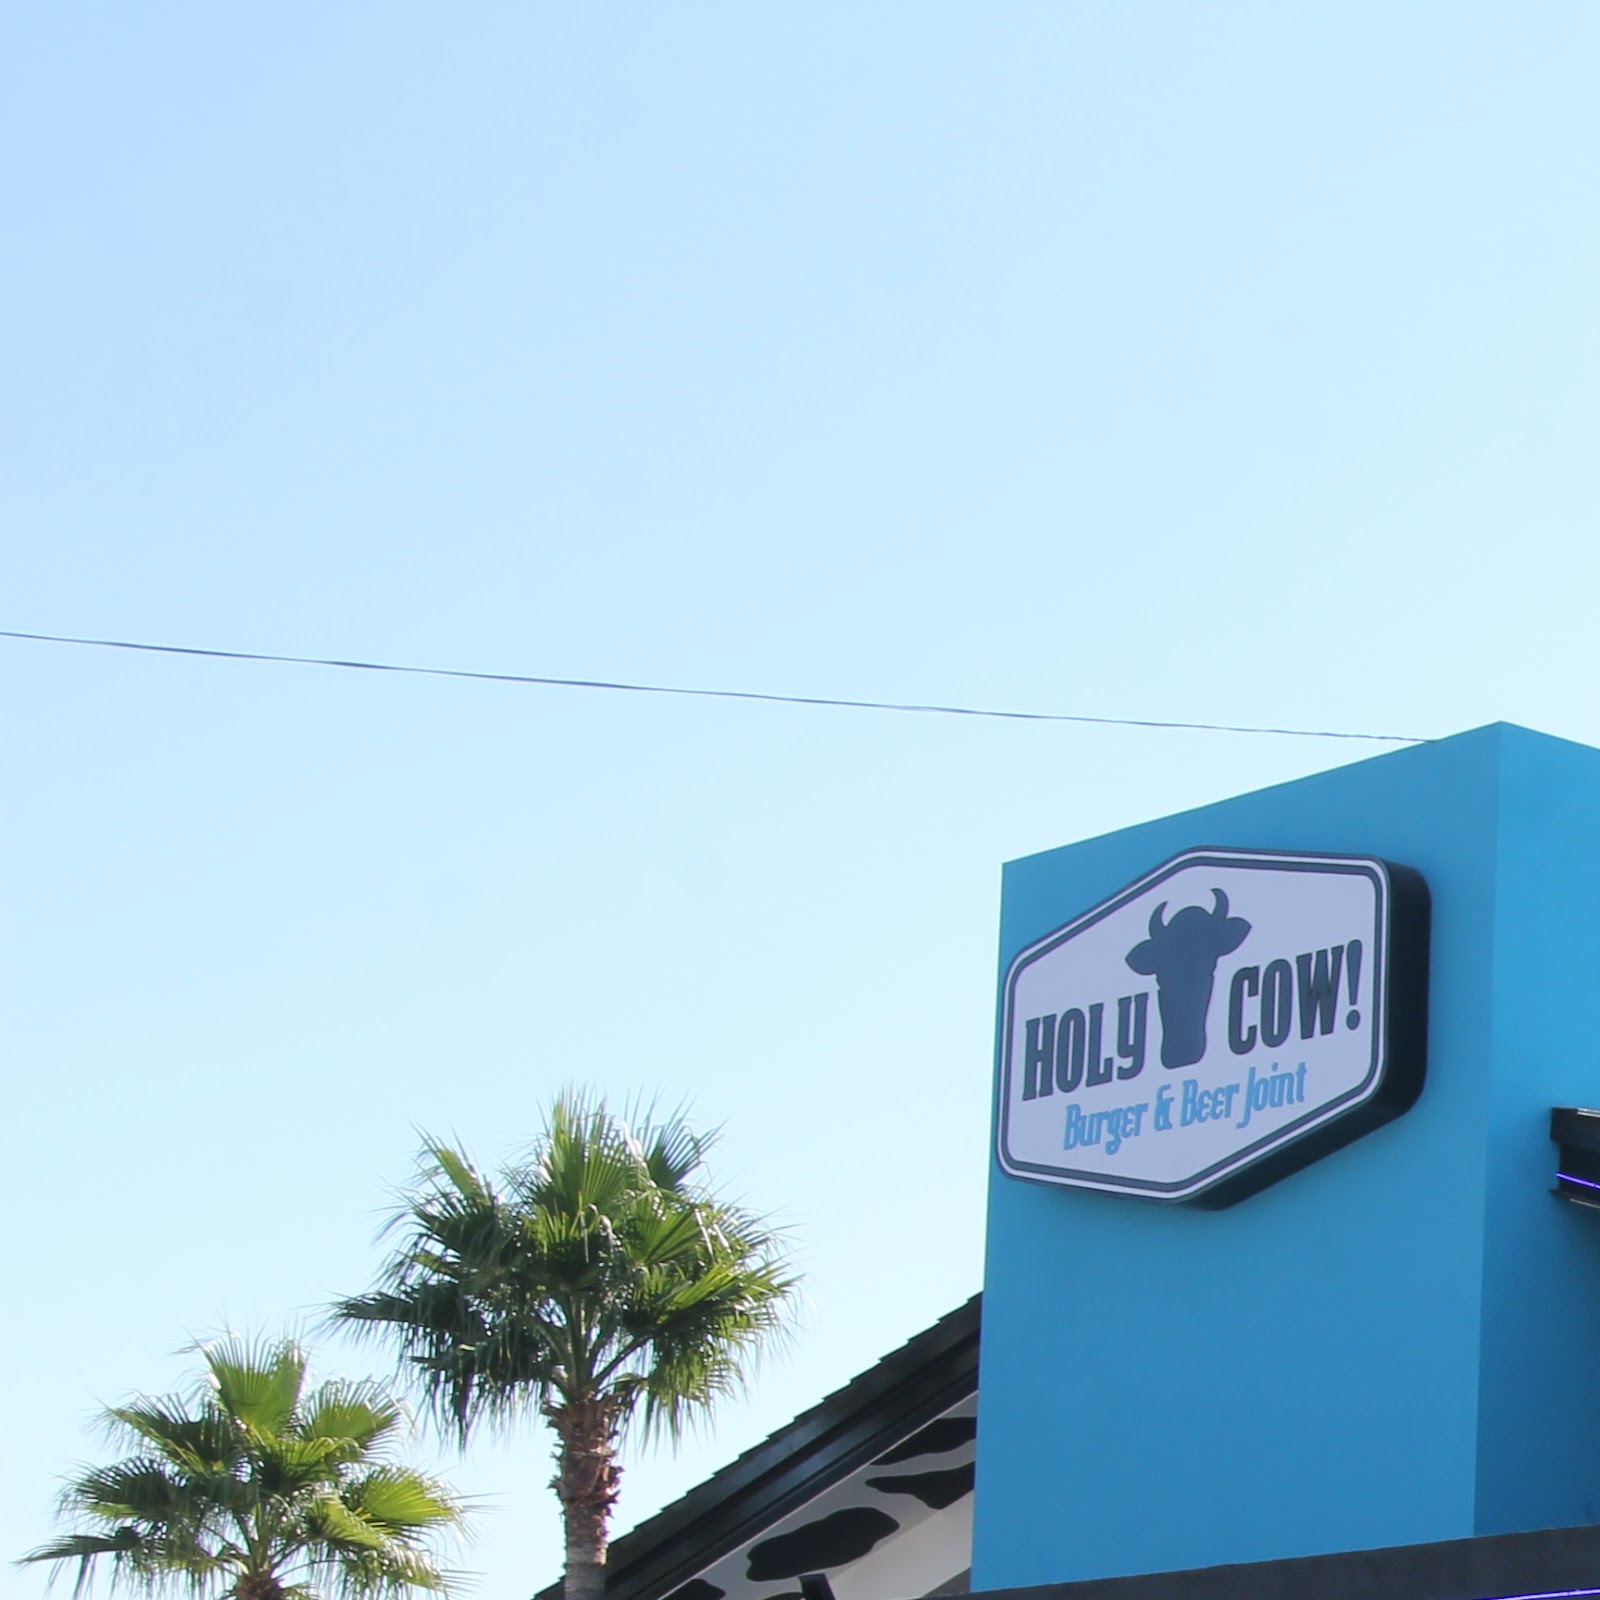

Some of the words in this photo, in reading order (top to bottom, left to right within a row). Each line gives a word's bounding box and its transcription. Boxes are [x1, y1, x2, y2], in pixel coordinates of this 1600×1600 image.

[1022, 992, 1149, 1101] HOLY
[1228, 939, 1363, 1055] COW!
[1062, 1102, 1148, 1156] Burger
[1153, 1084, 1173, 1132] &
[1180, 1078, 1240, 1128] Beer
[1236, 1061, 1307, 1129] Joint
